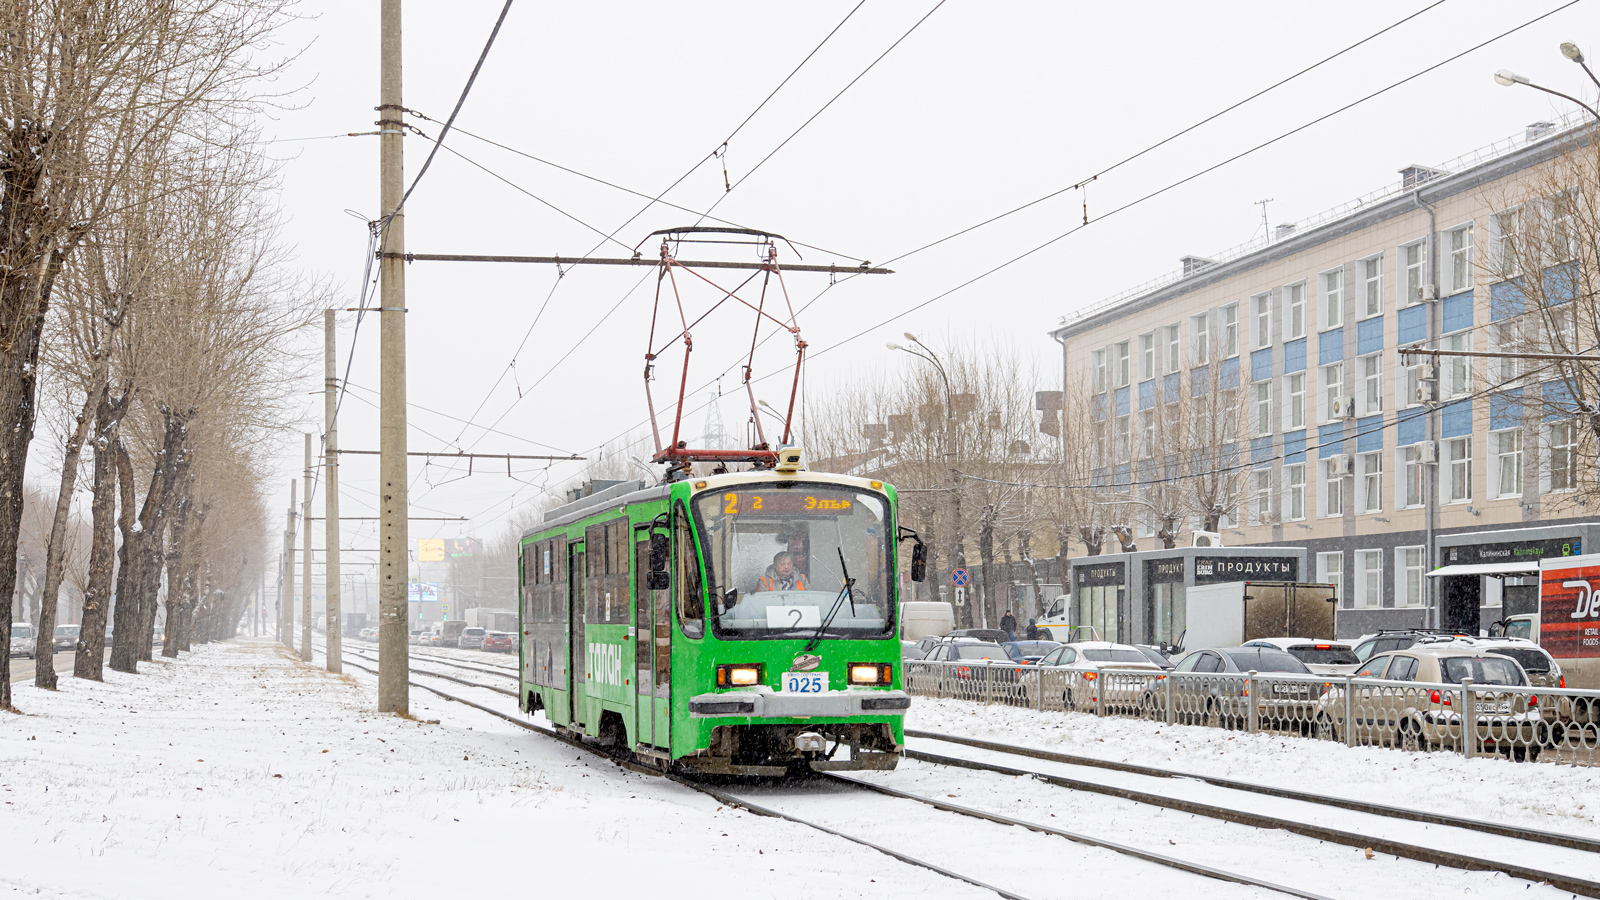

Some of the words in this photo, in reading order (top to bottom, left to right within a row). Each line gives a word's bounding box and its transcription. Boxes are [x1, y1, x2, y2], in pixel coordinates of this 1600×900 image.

[724, 493, 738, 514] 2
[1217, 562, 1290, 574] ПРОДУКТЫ
[788, 609, 802, 628] 2
[1584, 628, 1599, 636] RETAIL
[1582, 638, 1599, 646] FOODS
[788, 677, 822, 693] 025
